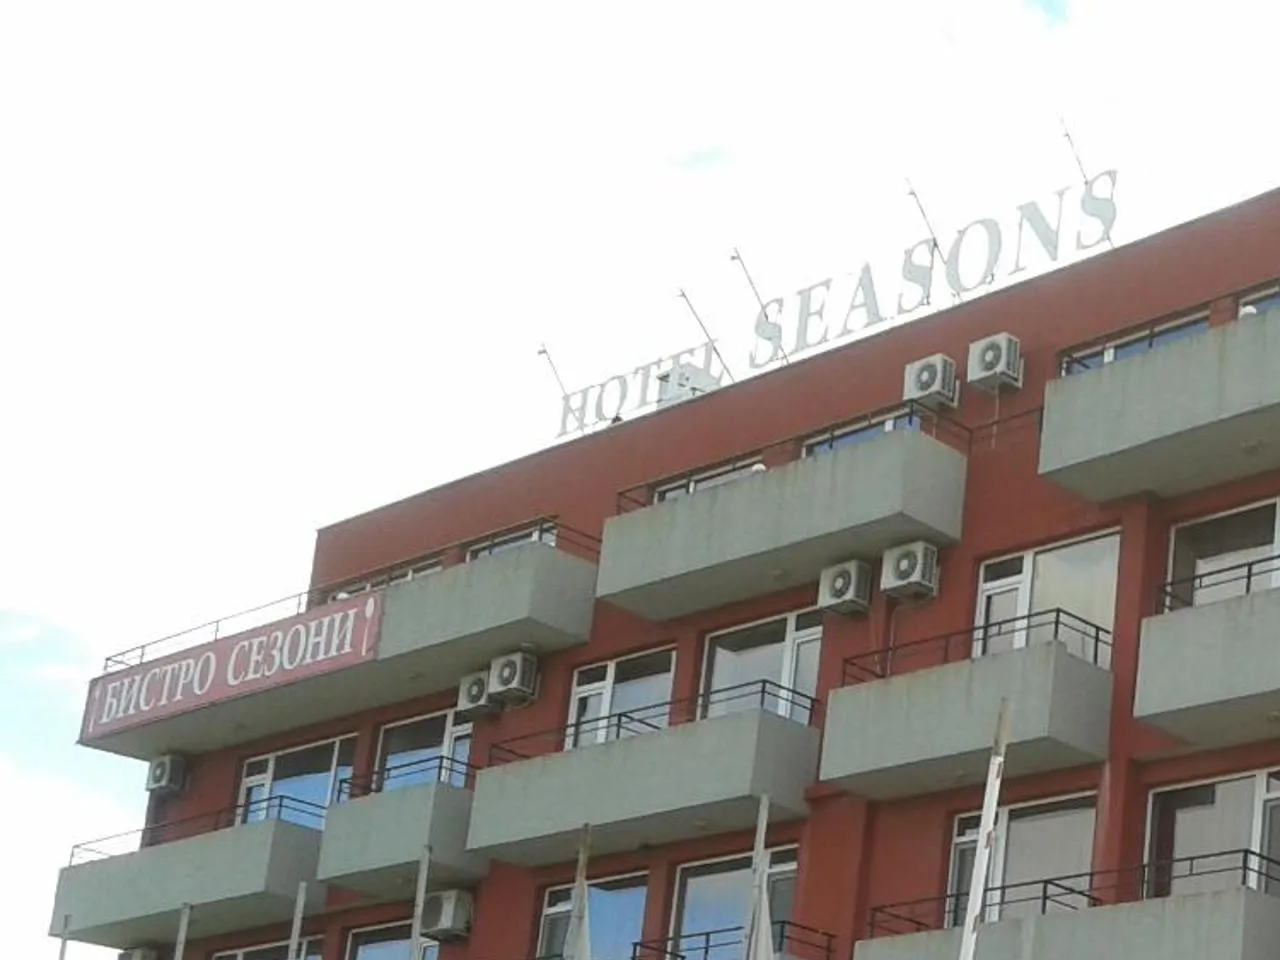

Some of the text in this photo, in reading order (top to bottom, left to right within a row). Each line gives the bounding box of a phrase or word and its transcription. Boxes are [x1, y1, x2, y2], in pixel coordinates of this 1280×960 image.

[555, 168, 1118, 438] HOTEL SEASONS
[99, 608, 358, 724] БИСТРО СЕЗОНИ
